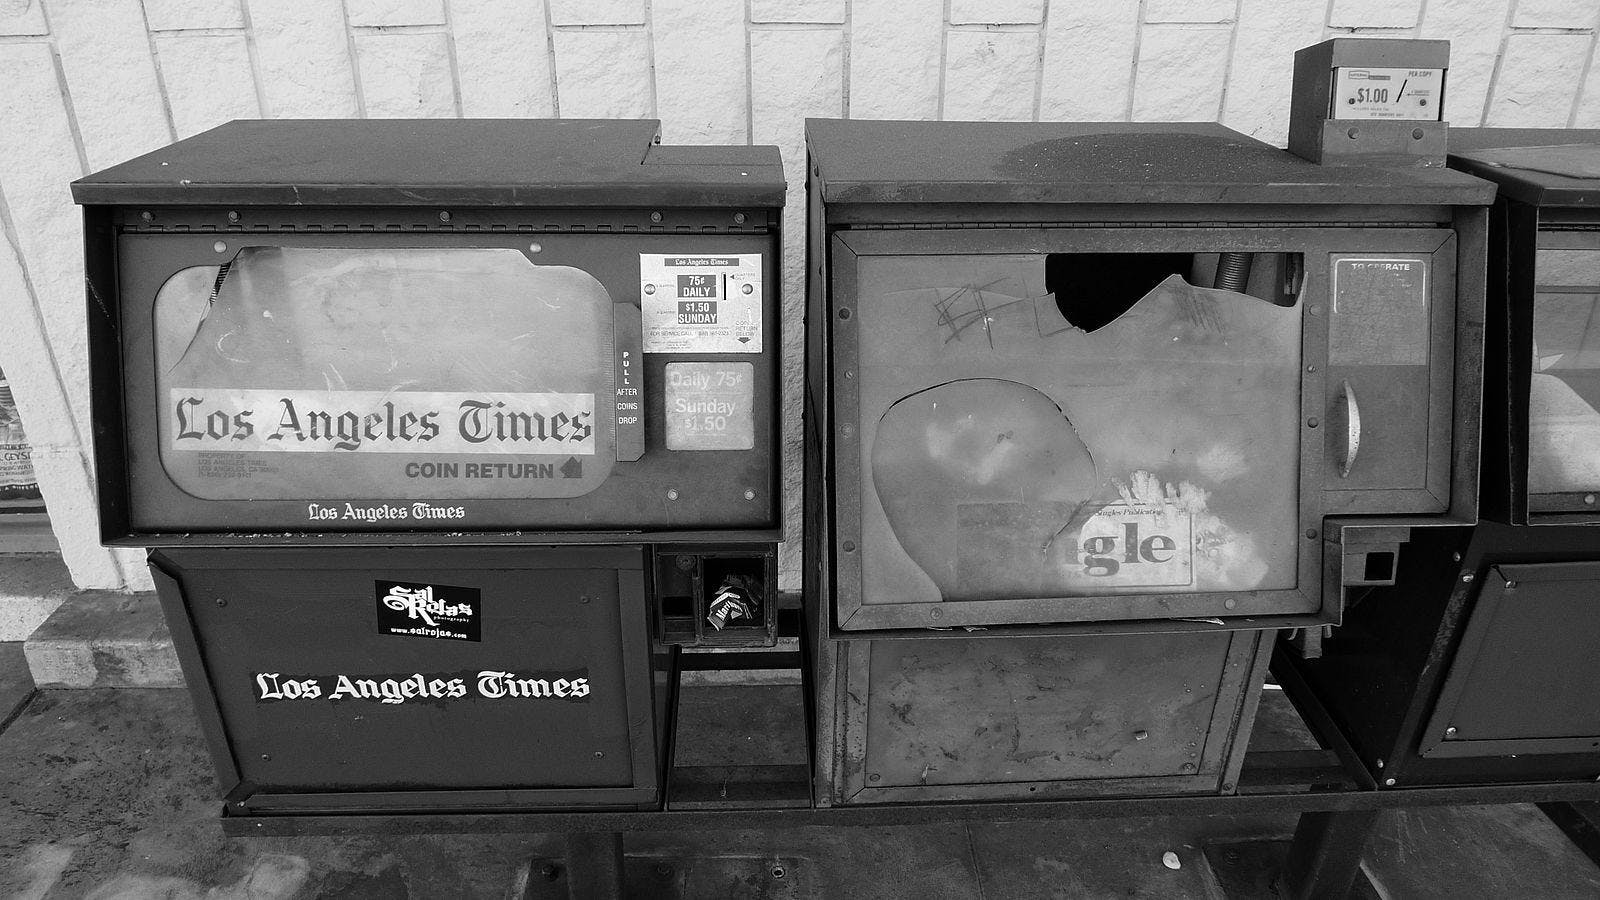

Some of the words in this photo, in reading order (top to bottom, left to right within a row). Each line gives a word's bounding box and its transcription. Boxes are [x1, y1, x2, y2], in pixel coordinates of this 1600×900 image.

[1357, 88, 1389, 103] $1.00
[688, 258, 709, 266] Angeles
[688, 276, 705, 286] 75¢
[683, 287, 711, 297] DAILY
[686, 303, 710, 312] $1.50
[678, 314, 717, 324] SUNDAY
[670, 371, 710, 390] Daily
[676, 398, 736, 416] Sunday
[176, 397, 255, 442] Los
[267, 398, 440, 451] Angeles
[459, 400, 592, 444] Times
[685, 416, 726, 431] $1.50
[405, 462, 458, 479] COIN
[466, 463, 554, 479] RETURN
[309, 503, 337, 520] Los
[341, 503, 408, 522] Angeles
[412, 502, 465, 520] Times
[389, 586, 433, 602] Sal
[390, 627, 467, 639] www.salrojas.com
[256, 672, 322, 700] Los
[328, 673, 467, 704] Angeles
[476, 671, 590, 699] Times
